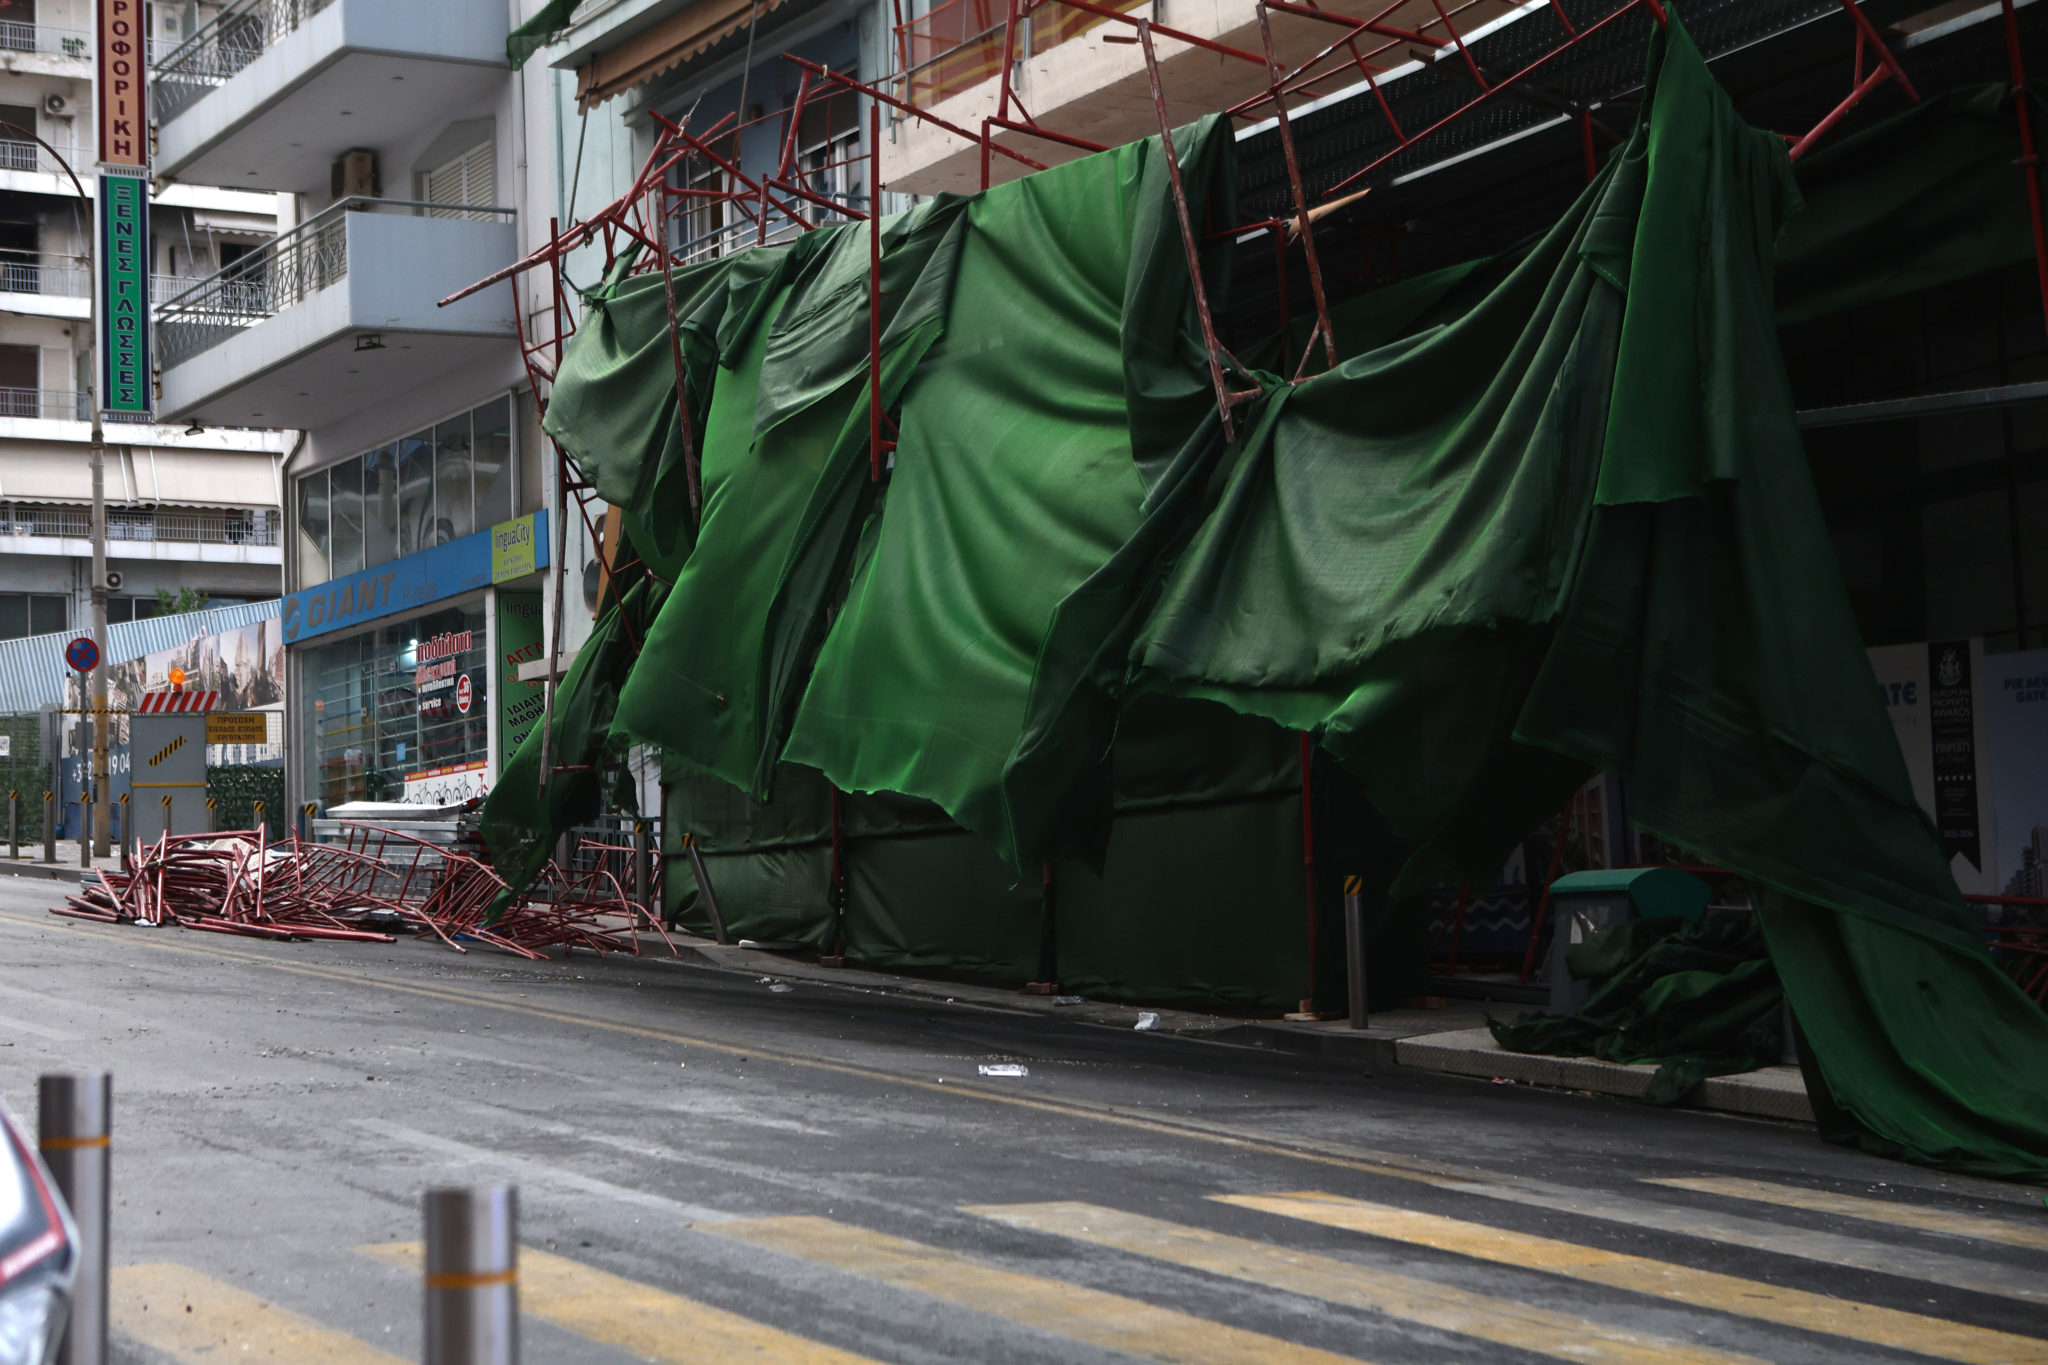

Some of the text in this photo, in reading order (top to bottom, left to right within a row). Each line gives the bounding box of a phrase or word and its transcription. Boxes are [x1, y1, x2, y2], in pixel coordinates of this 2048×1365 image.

[114, 185, 135, 404] ΞΕΝΕΣ ΓΛΩΣΣΕΣ
[494, 522, 531, 553] linguaCity
[307, 571, 396, 628] GIANT
[506, 599, 544, 619] lingua
[417, 630, 472, 664] ποδήλατα
[506, 640, 544, 667] ΑΓΓΛ
[422, 697, 442, 711] service
[507, 691, 545, 716] ΙΔΙΑΙΤ
[1880, 681, 1918, 705] ATE
[217, 716, 255, 724] ΠΡΟΣΟΧΗ
[508, 705, 545, 728] ΜΑΘΗ
[1932, 707, 1971, 719] AWARDS
